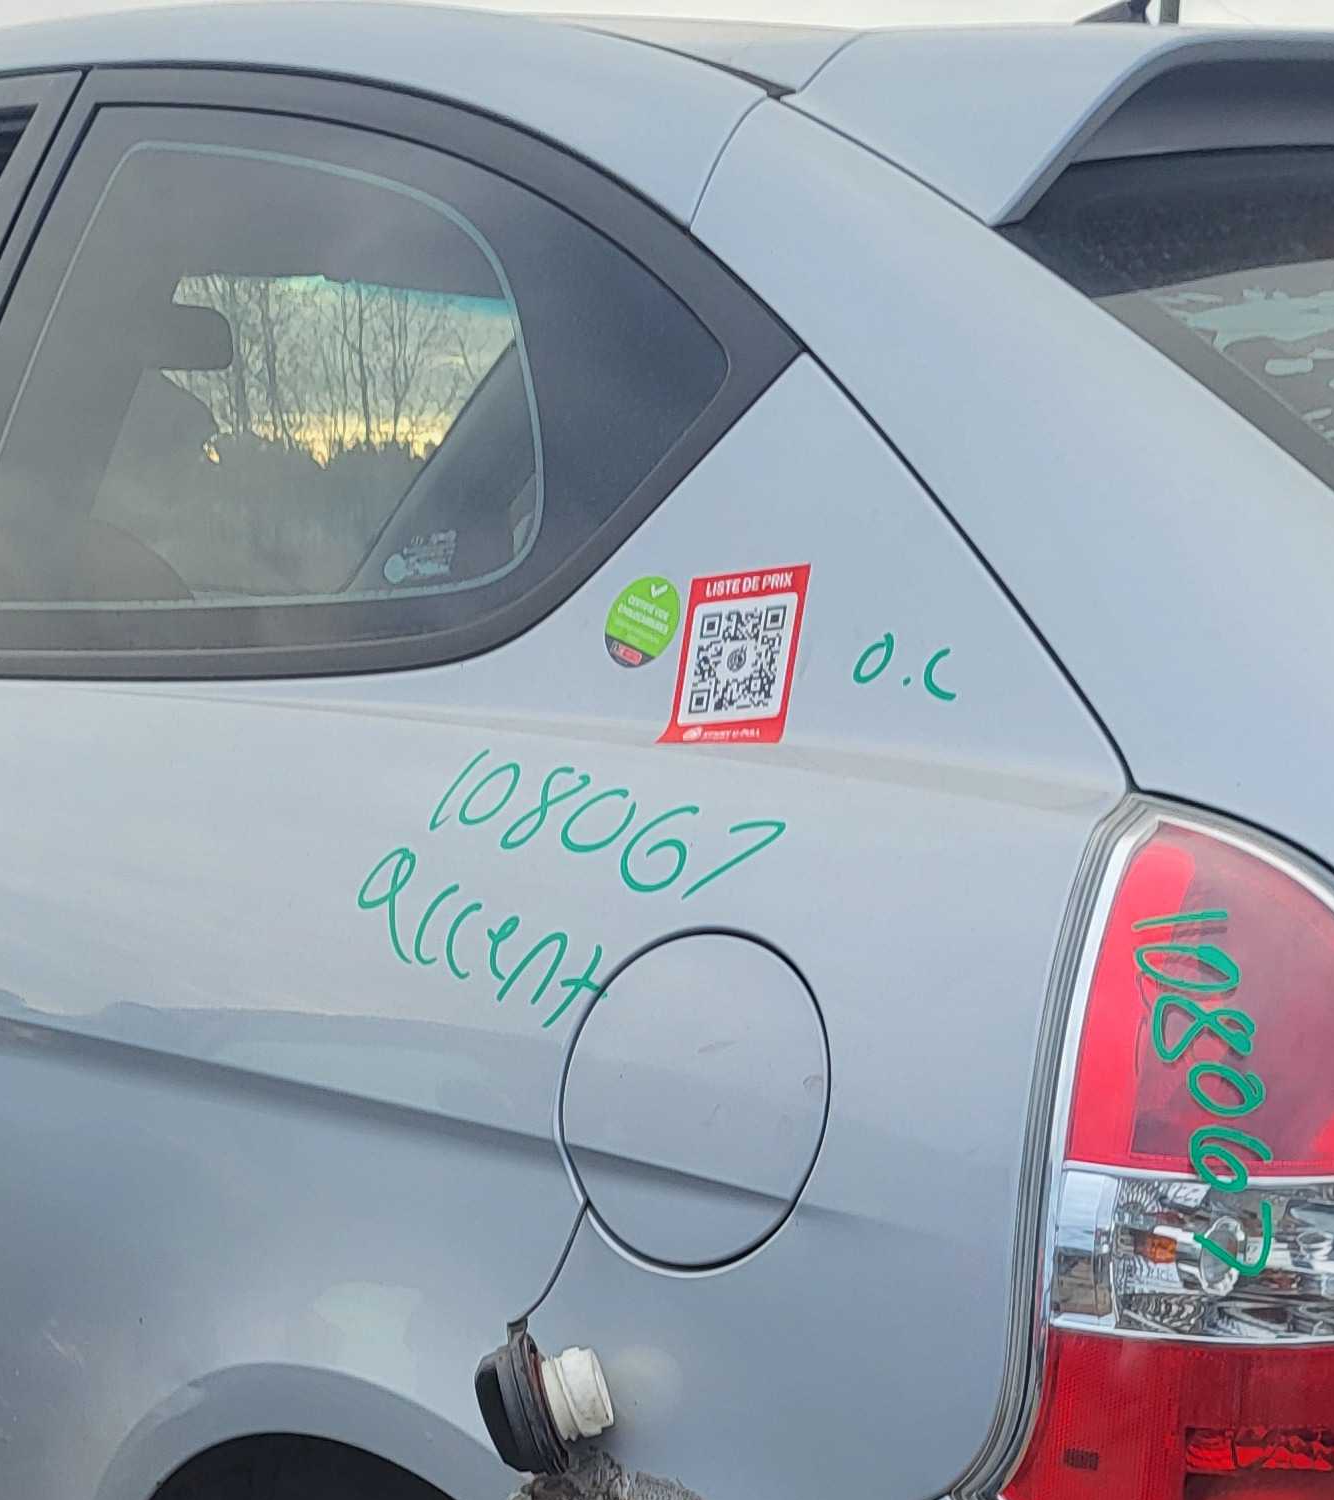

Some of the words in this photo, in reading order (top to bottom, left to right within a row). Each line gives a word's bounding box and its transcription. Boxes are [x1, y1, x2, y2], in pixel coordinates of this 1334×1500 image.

[705, 578, 741, 598] LISTE
[742, 575, 761, 593] DE
[762, 571, 794, 591] PRIX
[429, 749, 787, 900] 108067
[1130, 909, 1273, 1276] 108067
